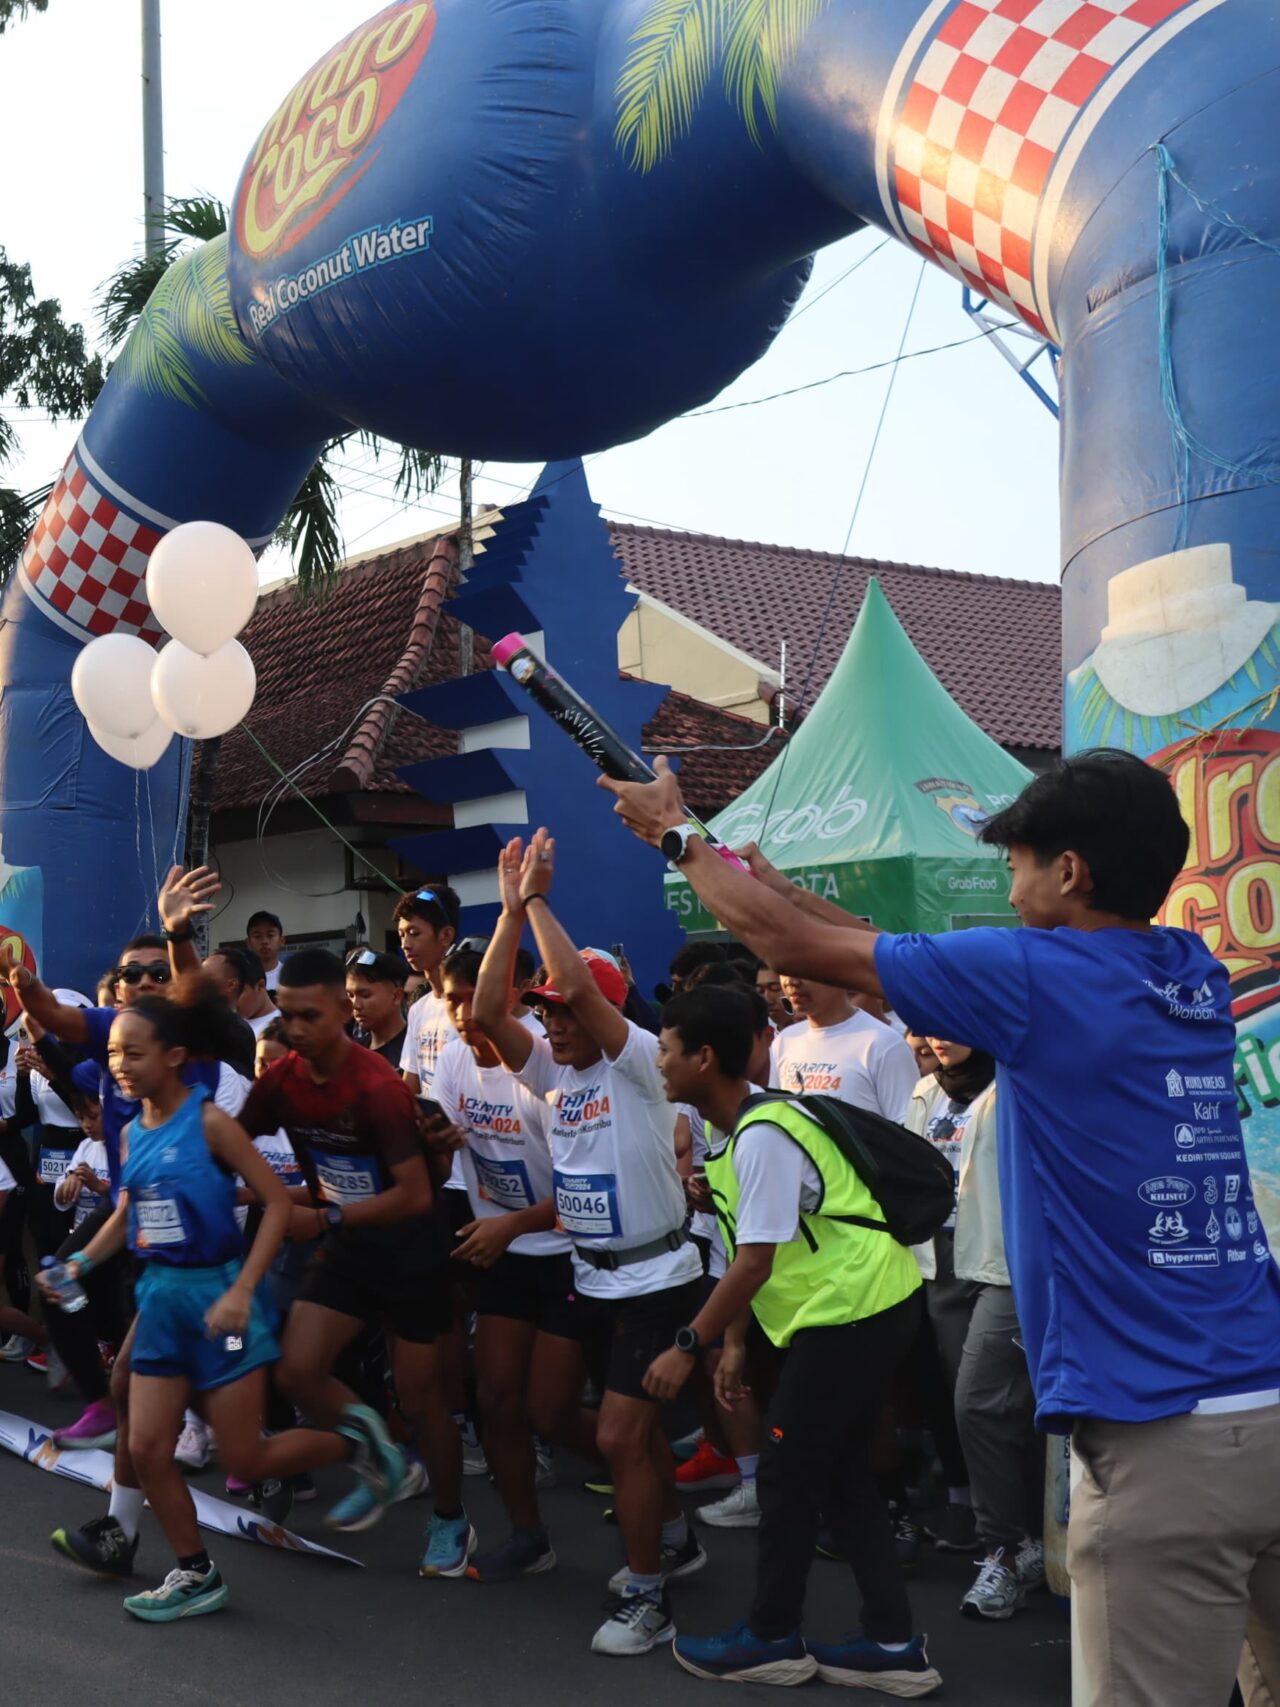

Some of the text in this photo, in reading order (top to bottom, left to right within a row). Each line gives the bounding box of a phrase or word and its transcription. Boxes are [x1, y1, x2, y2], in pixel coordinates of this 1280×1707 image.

[245, 75, 381, 253] Coco
[249, 219, 433, 333] Real Coconut Water
[712, 784, 869, 849] Grab
[948, 876, 997, 890] GrabFood
[665, 887, 694, 917] ES
[788, 1062, 838, 1073] CHARITY
[1193, 1101, 1221, 1120] Kahf
[1176, 1151, 1241, 1163] KEDIRI TOWN SQUARE
[559, 1192, 606, 1214] 50046
[1150, 1193, 1187, 1201] KILISUCI
[1165, 1252, 1217, 1265] hypermart
